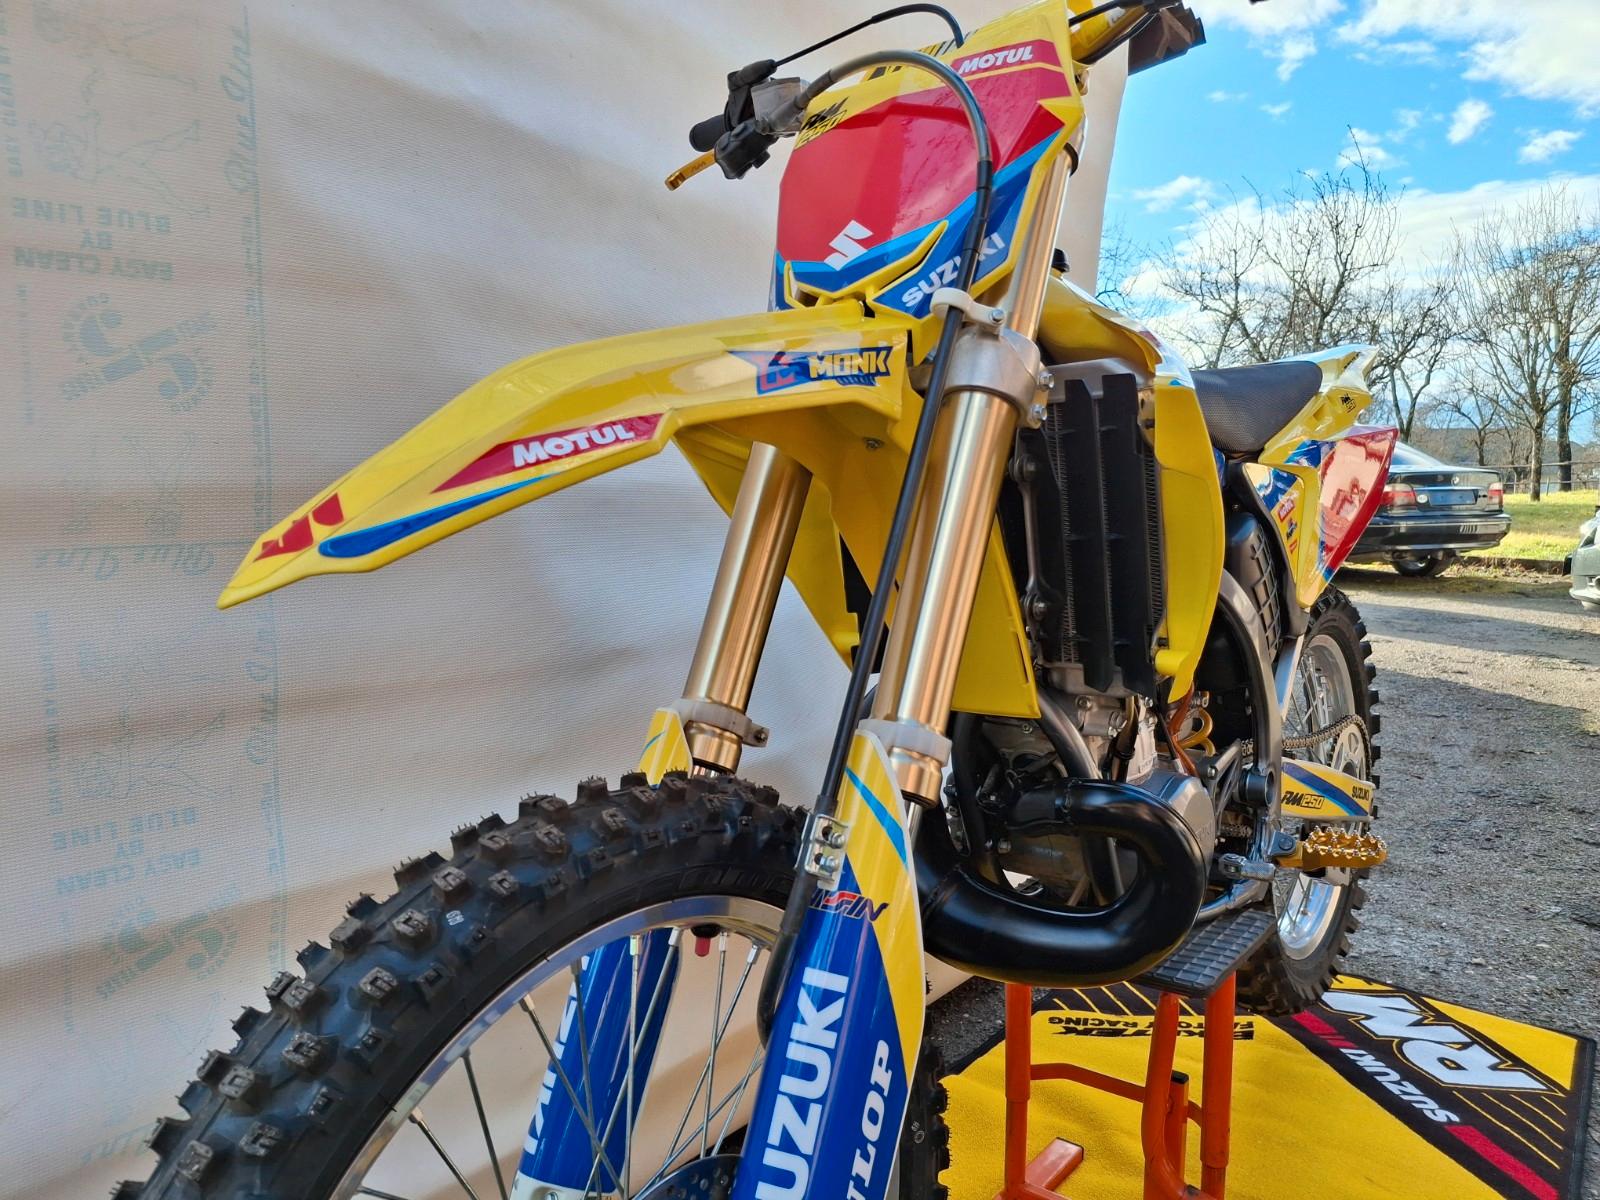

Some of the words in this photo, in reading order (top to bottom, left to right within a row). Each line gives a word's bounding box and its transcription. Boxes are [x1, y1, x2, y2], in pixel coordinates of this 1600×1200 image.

[958, 46, 1033, 74] MOTUL
[12, 197, 84, 226] LINE
[97, 207, 171, 235] BLUE
[79, 229, 113, 251] BY
[14, 247, 100, 275] CLEAN
[110, 257, 174, 282] EASY
[902, 232, 1005, 307] SUZKI
[808, 351, 887, 378] MONK
[513, 424, 635, 467] MOTUL
[1351, 786, 1370, 801] SUZUKI
[1048, 1016, 1138, 1028] RACING
[1143, 1015, 1254, 1030] FTOY
[1320, 990, 1550, 1091] RM
[1339, 1048, 1460, 1122] SUZUKI
